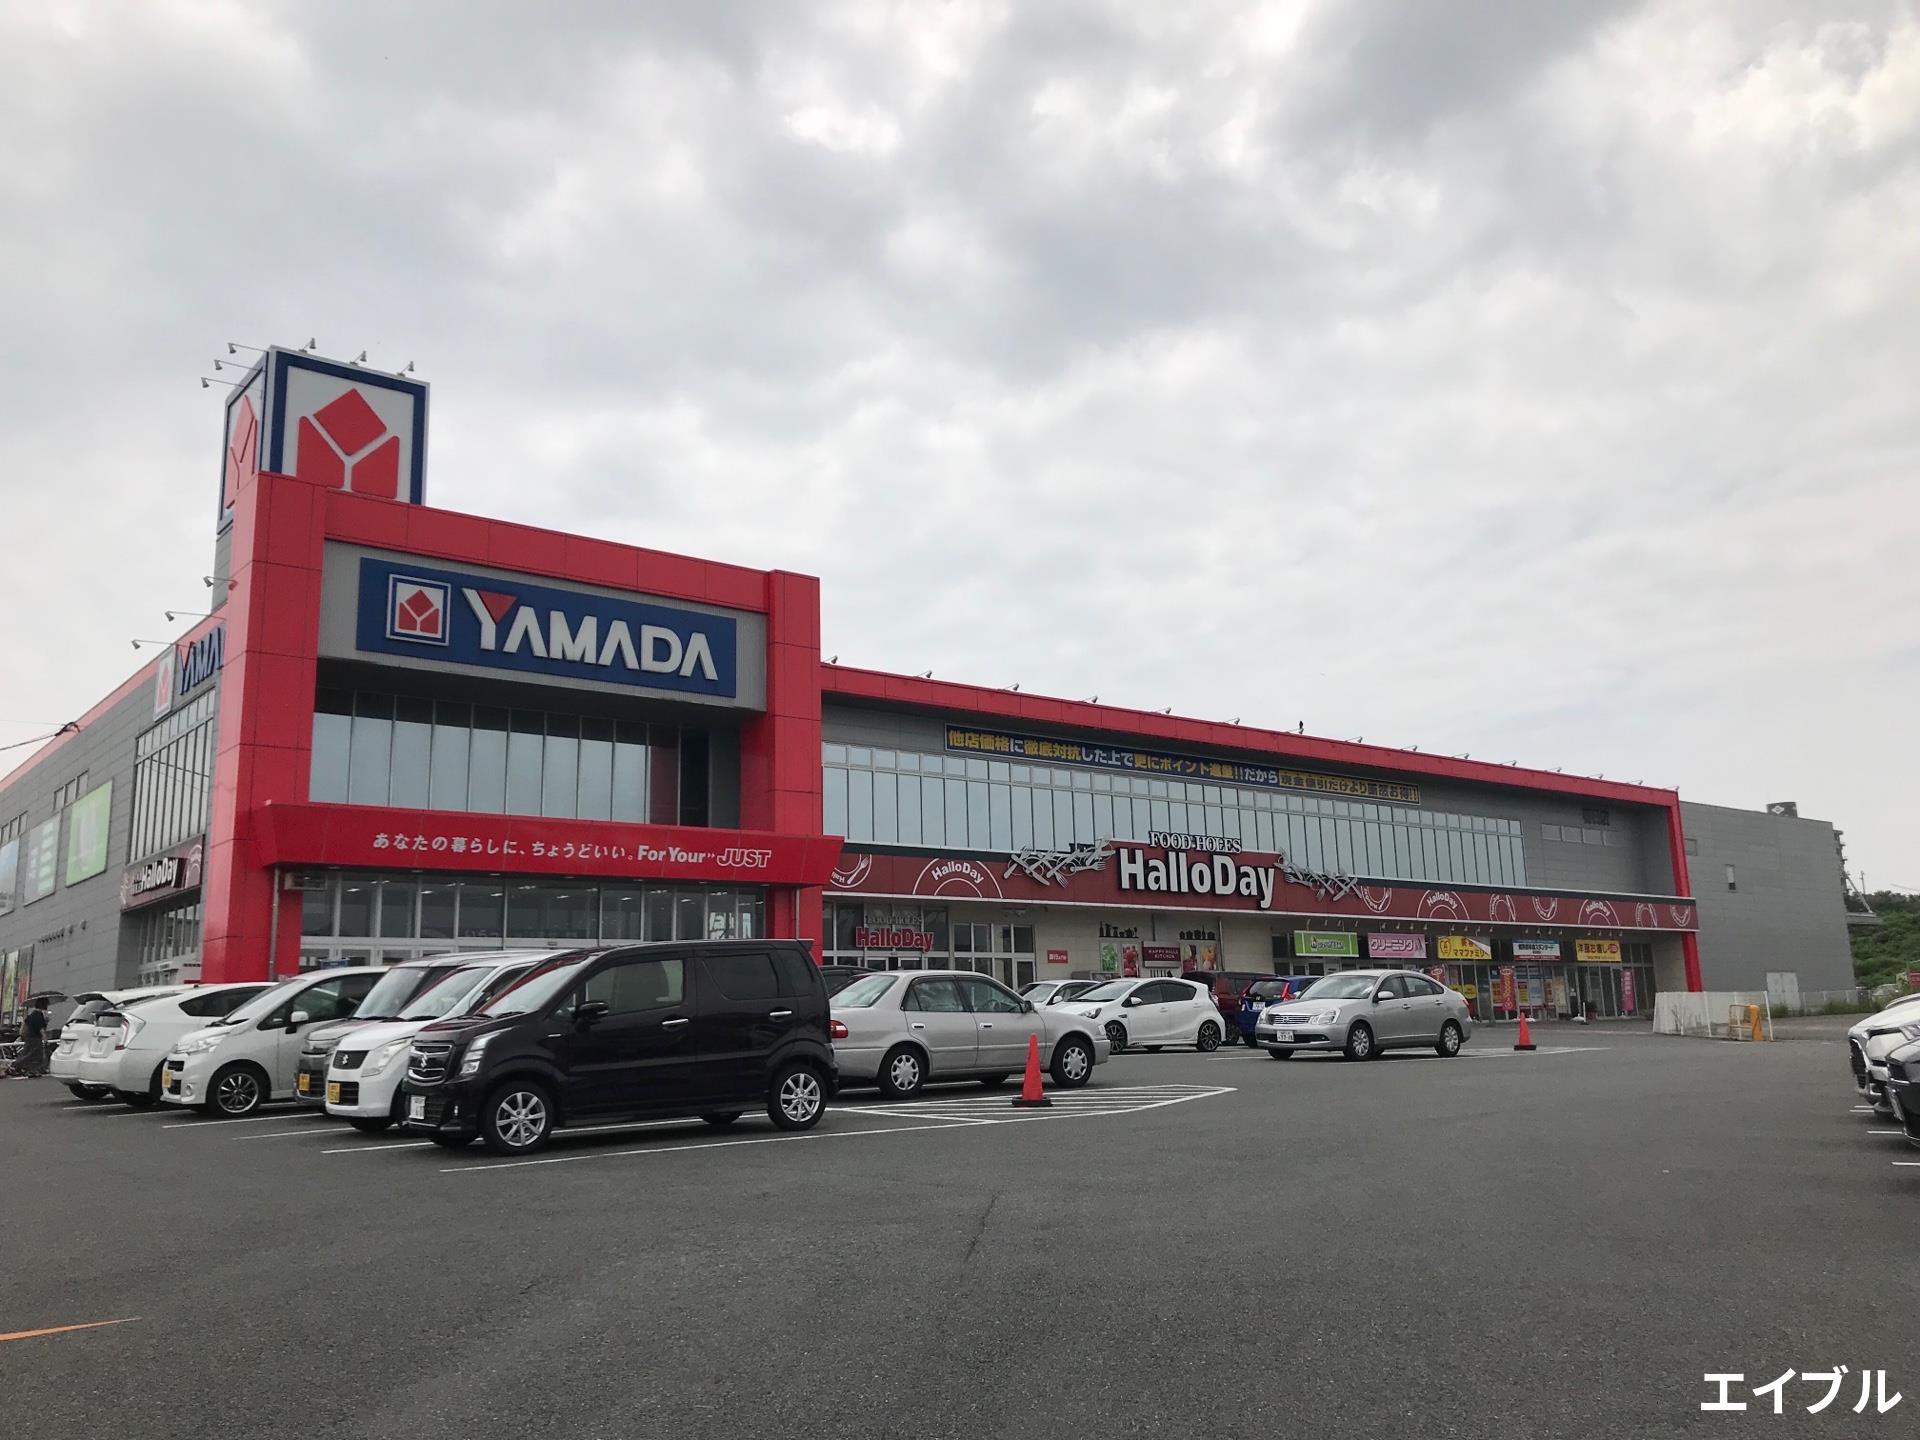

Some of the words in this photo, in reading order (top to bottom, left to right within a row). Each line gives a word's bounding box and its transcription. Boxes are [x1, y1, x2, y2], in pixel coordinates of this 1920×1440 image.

[462, 586, 720, 682] YAMADA
[176, 627, 225, 695] YAMA
[372, 831, 635, 861] あなたの暮らしに、ちょうどいい。
[637, 844, 668, 862] For
[669, 845, 706, 864] Your
[716, 848, 772, 869] JUST
[141, 857, 179, 891] HalloDay
[931, 860, 985, 885] HalloDay
[1119, 847, 1275, 909] HalloDay
[1426, 891, 1459, 909] HalloDay
[855, 926, 935, 954] HalloDay
[1370, 938, 1414, 951] クリーニング
